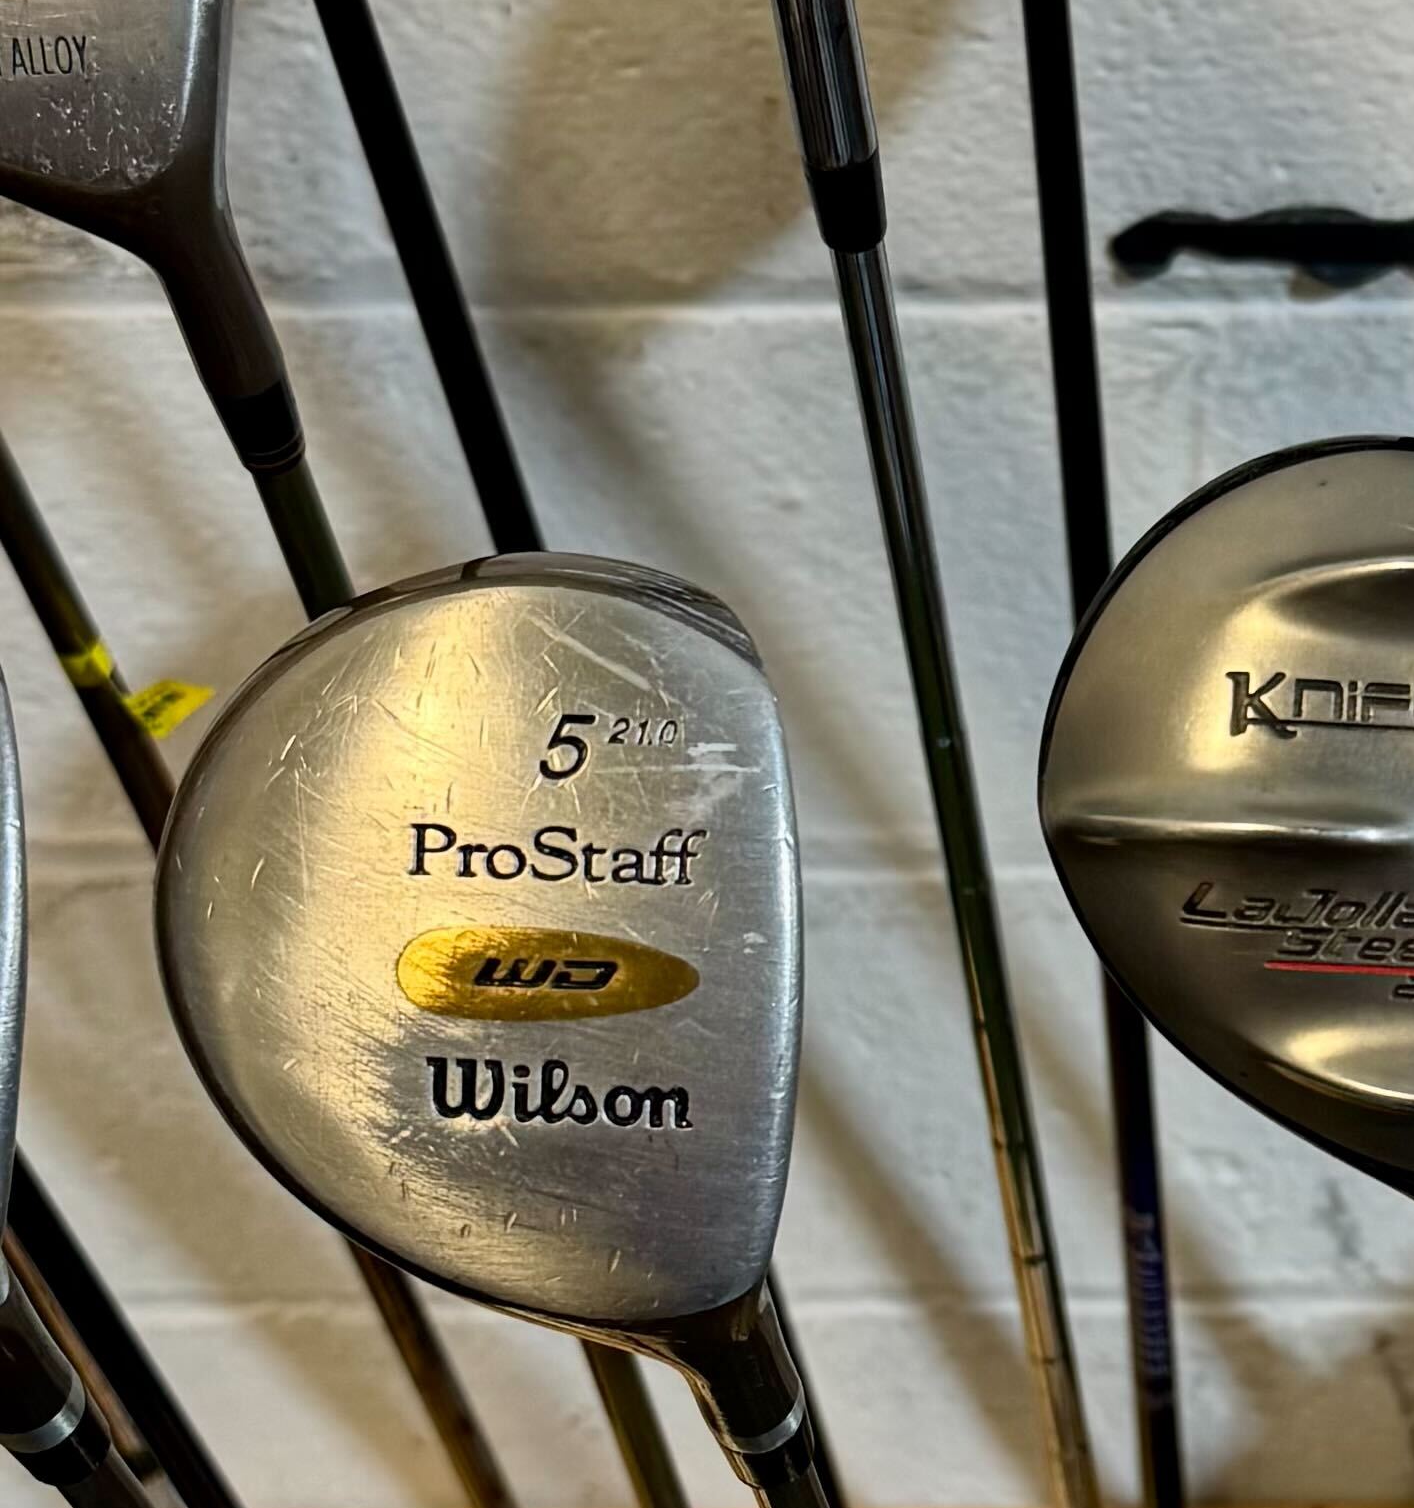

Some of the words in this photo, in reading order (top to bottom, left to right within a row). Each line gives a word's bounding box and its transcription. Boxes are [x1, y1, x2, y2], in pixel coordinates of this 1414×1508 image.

[12, 35, 87, 76] ALLOY
[539, 713, 597, 781] 5
[608, 717, 678, 746] 21.0
[408, 822, 709, 886] ProStaff
[426, 1055, 694, 1129] Wilson
